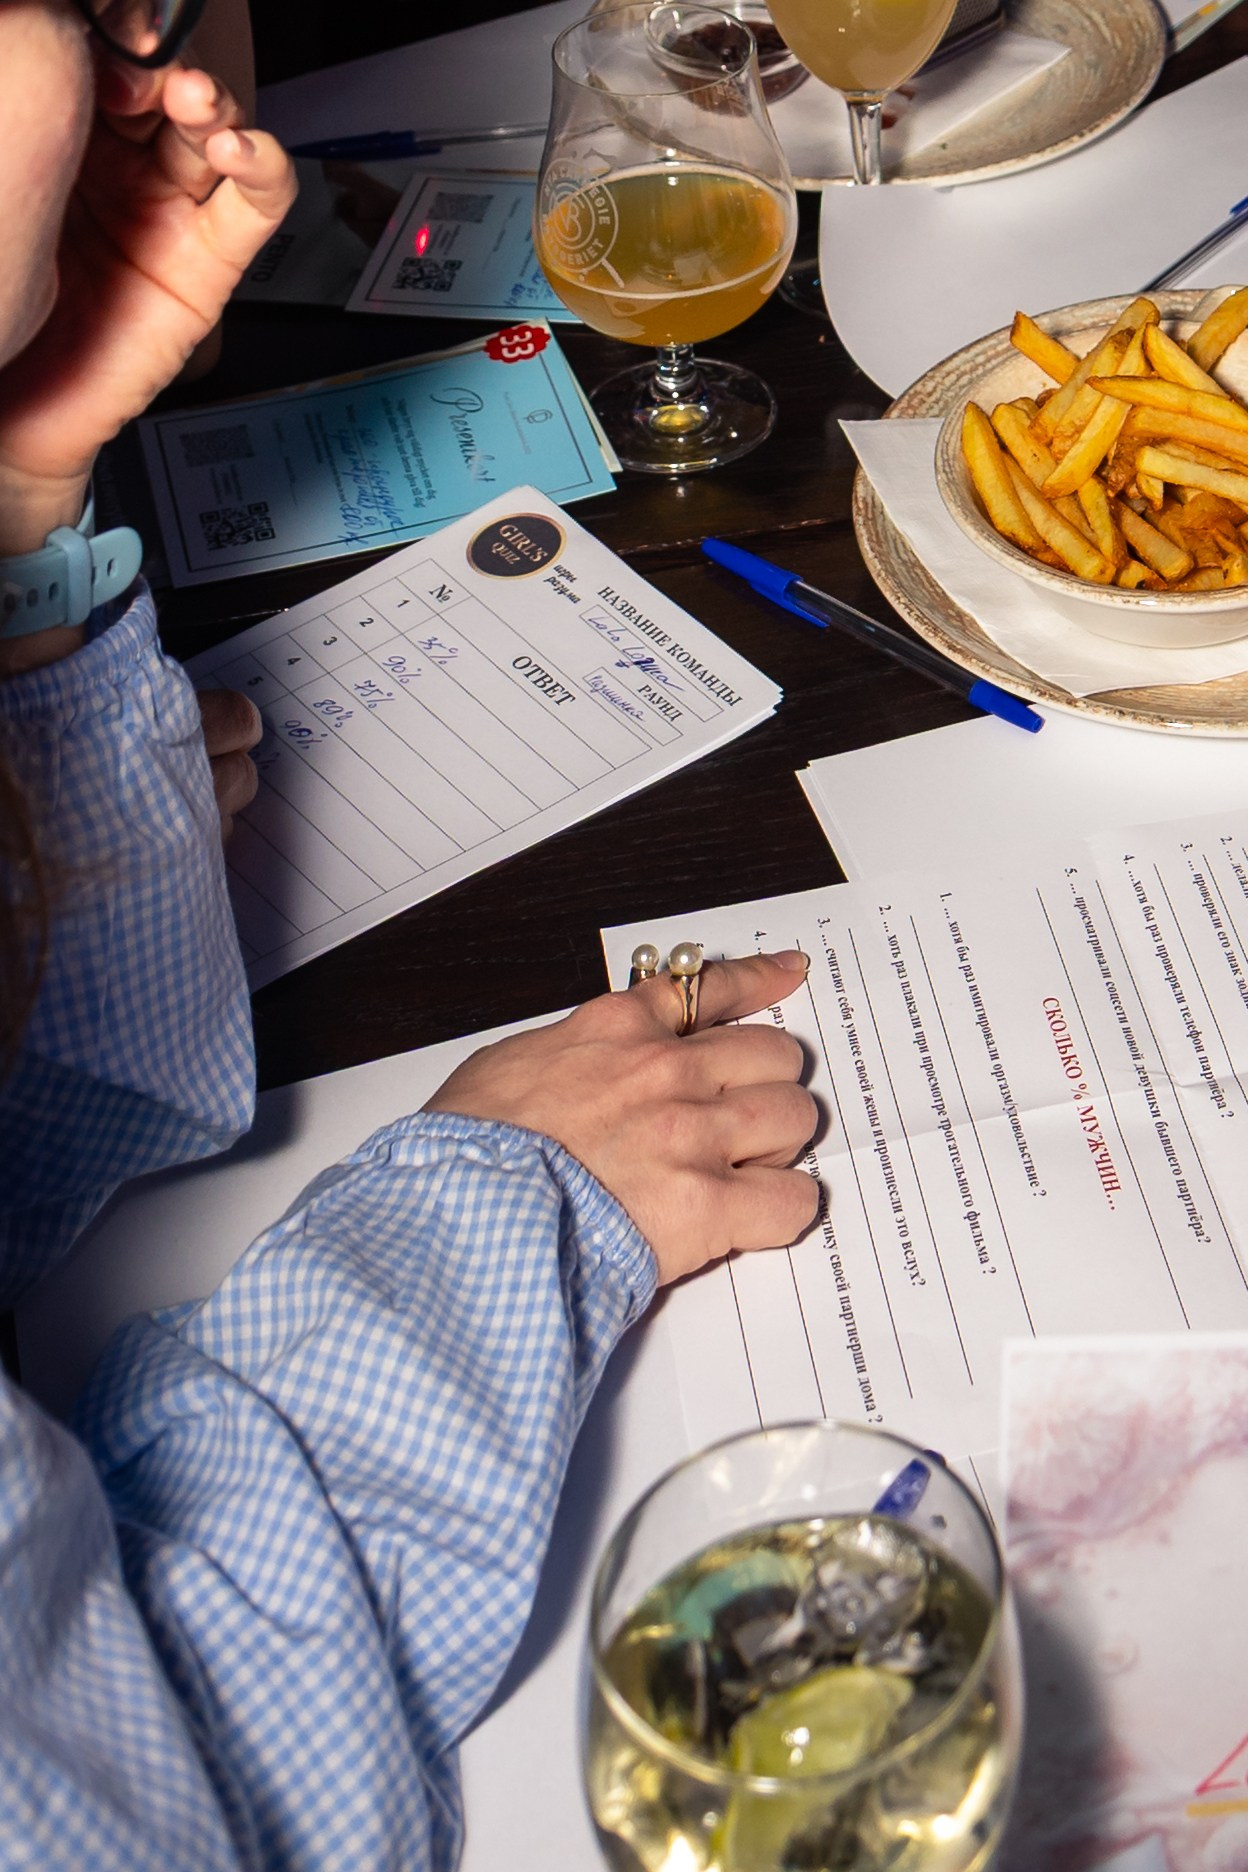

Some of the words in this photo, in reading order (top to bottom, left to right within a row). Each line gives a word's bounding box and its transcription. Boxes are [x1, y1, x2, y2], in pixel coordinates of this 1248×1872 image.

[499, 329, 535, 359] 33
[489, 539, 521, 567] QUIZ
[497, 523, 548, 563] GIRL'S
[544, 574, 581, 605] разума
[554, 565, 577, 584] игры
[397, 598, 409, 608] 1
[359, 616, 374, 628] 2
[322, 635, 337, 647] 3
[597, 587, 672, 646] НАЗВАНИЕ
[666, 644, 743, 706] КОМАНДЫ
[286, 658, 300, 667] 4
[248, 675, 263, 687] 5
[510, 654, 576, 707] ОТВЕТ
[636, 684, 682, 721] РАУНД
[1219, 836, 1233, 845] 2.
[1123, 854, 1135, 865] 4.
[939, 892, 952, 902] 1.
[1128, 870, 1149, 904] ...хотя
[817, 917, 831, 928] 3.
[878, 904, 892, 915] 2.
[1141, 905, 1155, 922] бы
[1180, 843, 1193, 852] 3.
[1192, 873, 1223, 929] проверяли
[1216, 931, 1231, 948] его
[1224, 949, 1243, 976] знак
[754, 930, 767, 941] 4.
[887, 934, 901, 959] хоть
[948, 920, 963, 944] хотя
[1144, 923, 1163, 943] раз
[890, 960, 908, 979] раз
[955, 945, 970, 963] бы
[825, 947, 846, 993] считают
[957, 964, 976, 983] раз
[1154, 944, 1187, 1004] проверяли
[767, 1005, 785, 1026] раз
[837, 996, 854, 1021] себя
[900, 980, 922, 1029] плакали
[968, 984, 1000, 1061] имитировали
[1042, 997, 1083, 1079] СКОЛЬКО
[1179, 1005, 1205, 1053] телефон
[840, 1022, 862, 1057] умнее
[912, 1030, 930, 1053] при
[1064, 867, 1078, 877] 5.
[1073, 896, 1112, 979] просматривали
[1105, 981, 1129, 1024] соцсети
[1121, 1026, 1145, 1061] новой
[1133, 1063, 1161, 1118] девушки
[1154, 1121, 1183, 1176] бывшего
[1175, 1178, 1211, 1243] партнёра?
[854, 1059, 875, 1092] своей
[919, 1055, 947, 1116] просмотре
[1070, 1082, 1090, 1100] %
[1197, 1055, 1227, 1110] партнёра
[862, 1093, 881, 1128] жены
[990, 1063, 1040, 1187] оргазм/удовольствие
[872, 1129, 883, 1137] и
[937, 1117, 974, 1208] трогательного
[1076, 1104, 1122, 1210] МУЖЧИН...
[873, 1138, 903, 1214] произнесли
[895, 1215, 910, 1238] это
[962, 1210, 990, 1265] фильма
[829, 1253, 851, 1292] своей
[901, 1240, 926, 1286] вслух?
[838, 1295, 867, 1374] партнерши
[857, 1377, 876, 1412] дома
